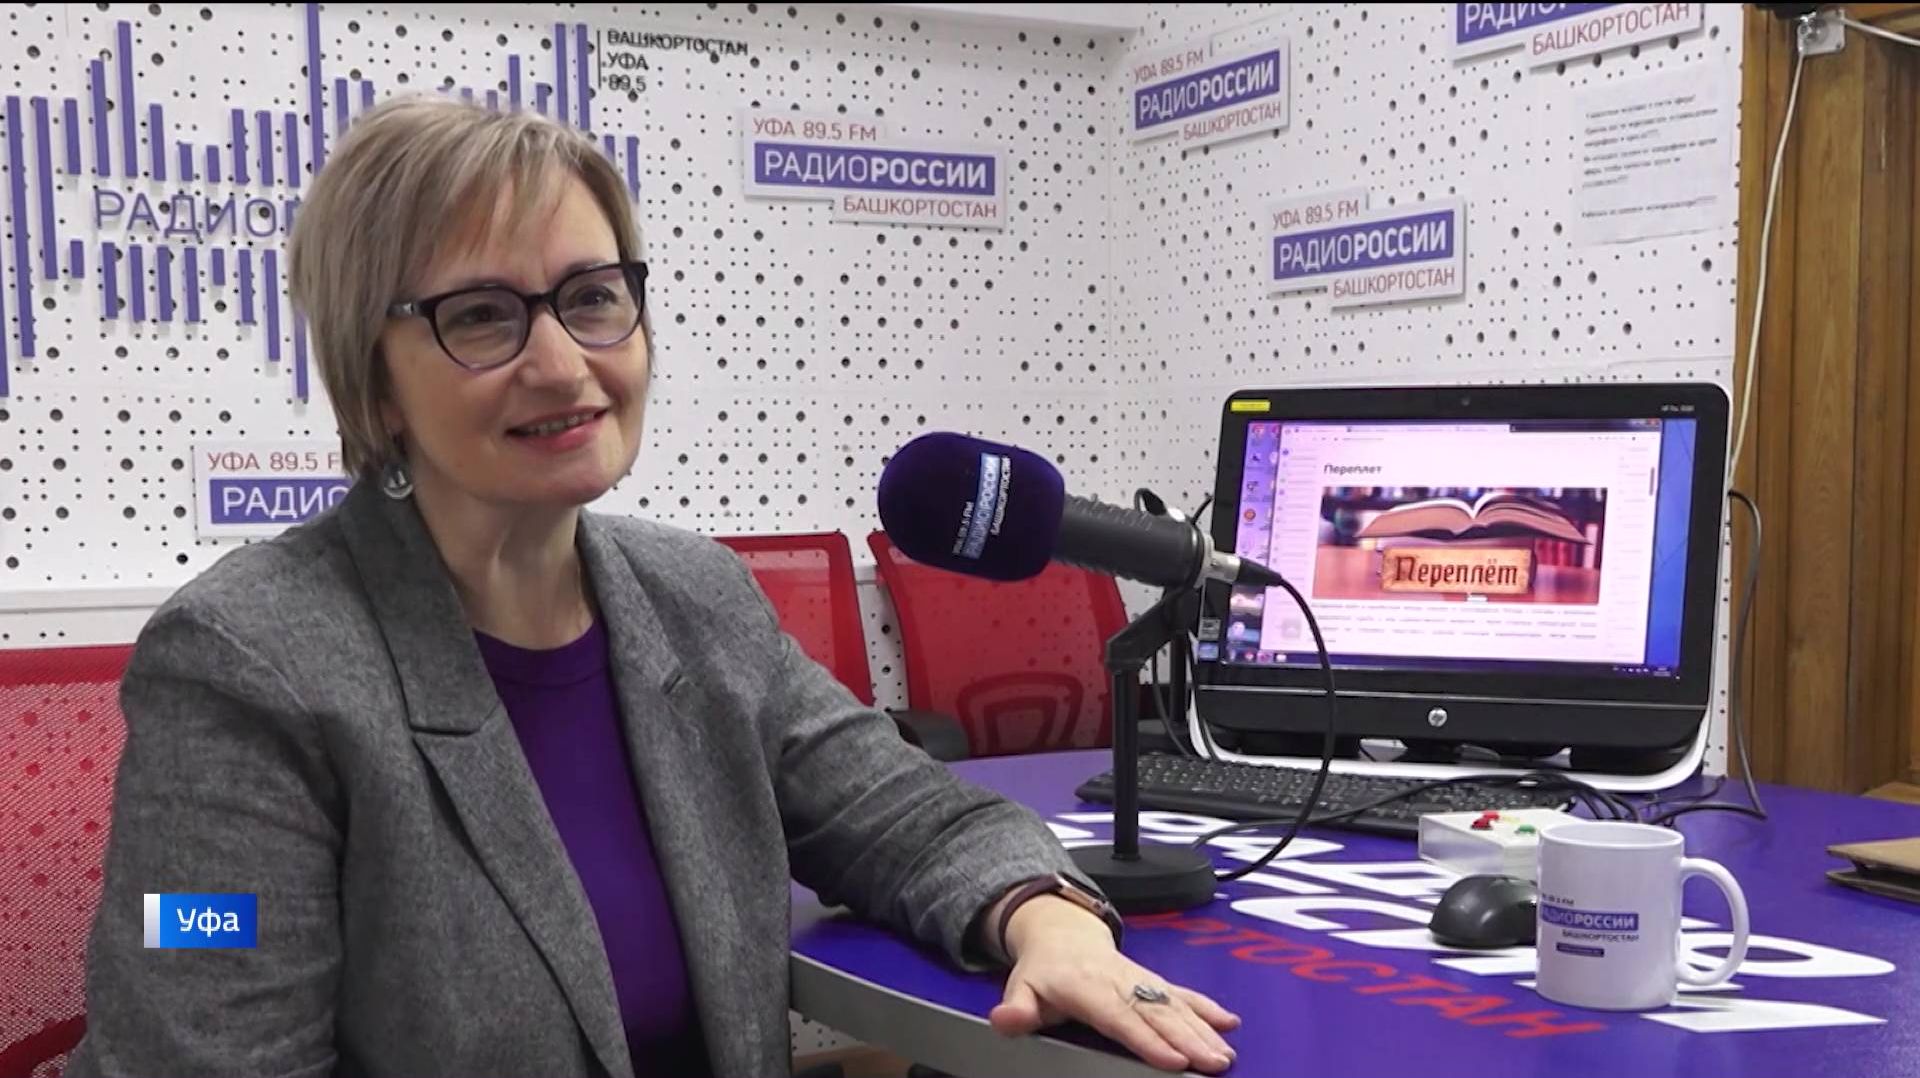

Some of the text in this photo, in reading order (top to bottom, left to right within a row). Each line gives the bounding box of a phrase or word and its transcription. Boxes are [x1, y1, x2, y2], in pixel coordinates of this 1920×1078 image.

[1532, 3, 1690, 55] БАШКОРТОСТАН
[607, 52, 648, 70] УФА
[1186, 49, 1204, 68] FM
[1139, 59, 1275, 122] РАДИОРОССИИ
[752, 117, 877, 142] УФА 89.5 FM
[1183, 101, 1281, 140] БАШКОРТОСТАН
[763, 149, 987, 189] РАДИОРОССИИ
[842, 195, 998, 219] БАШКОРТОСТАН
[1273, 199, 1360, 230] УФА 89.5 FM
[1279, 219, 1447, 273] РАДИОРОССИИ
[1333, 266, 1456, 298] БАШКОРТОСТАН
[208, 451, 341, 472] УФА 89.5 F
[1394, 555, 1519, 588] Переплёт
